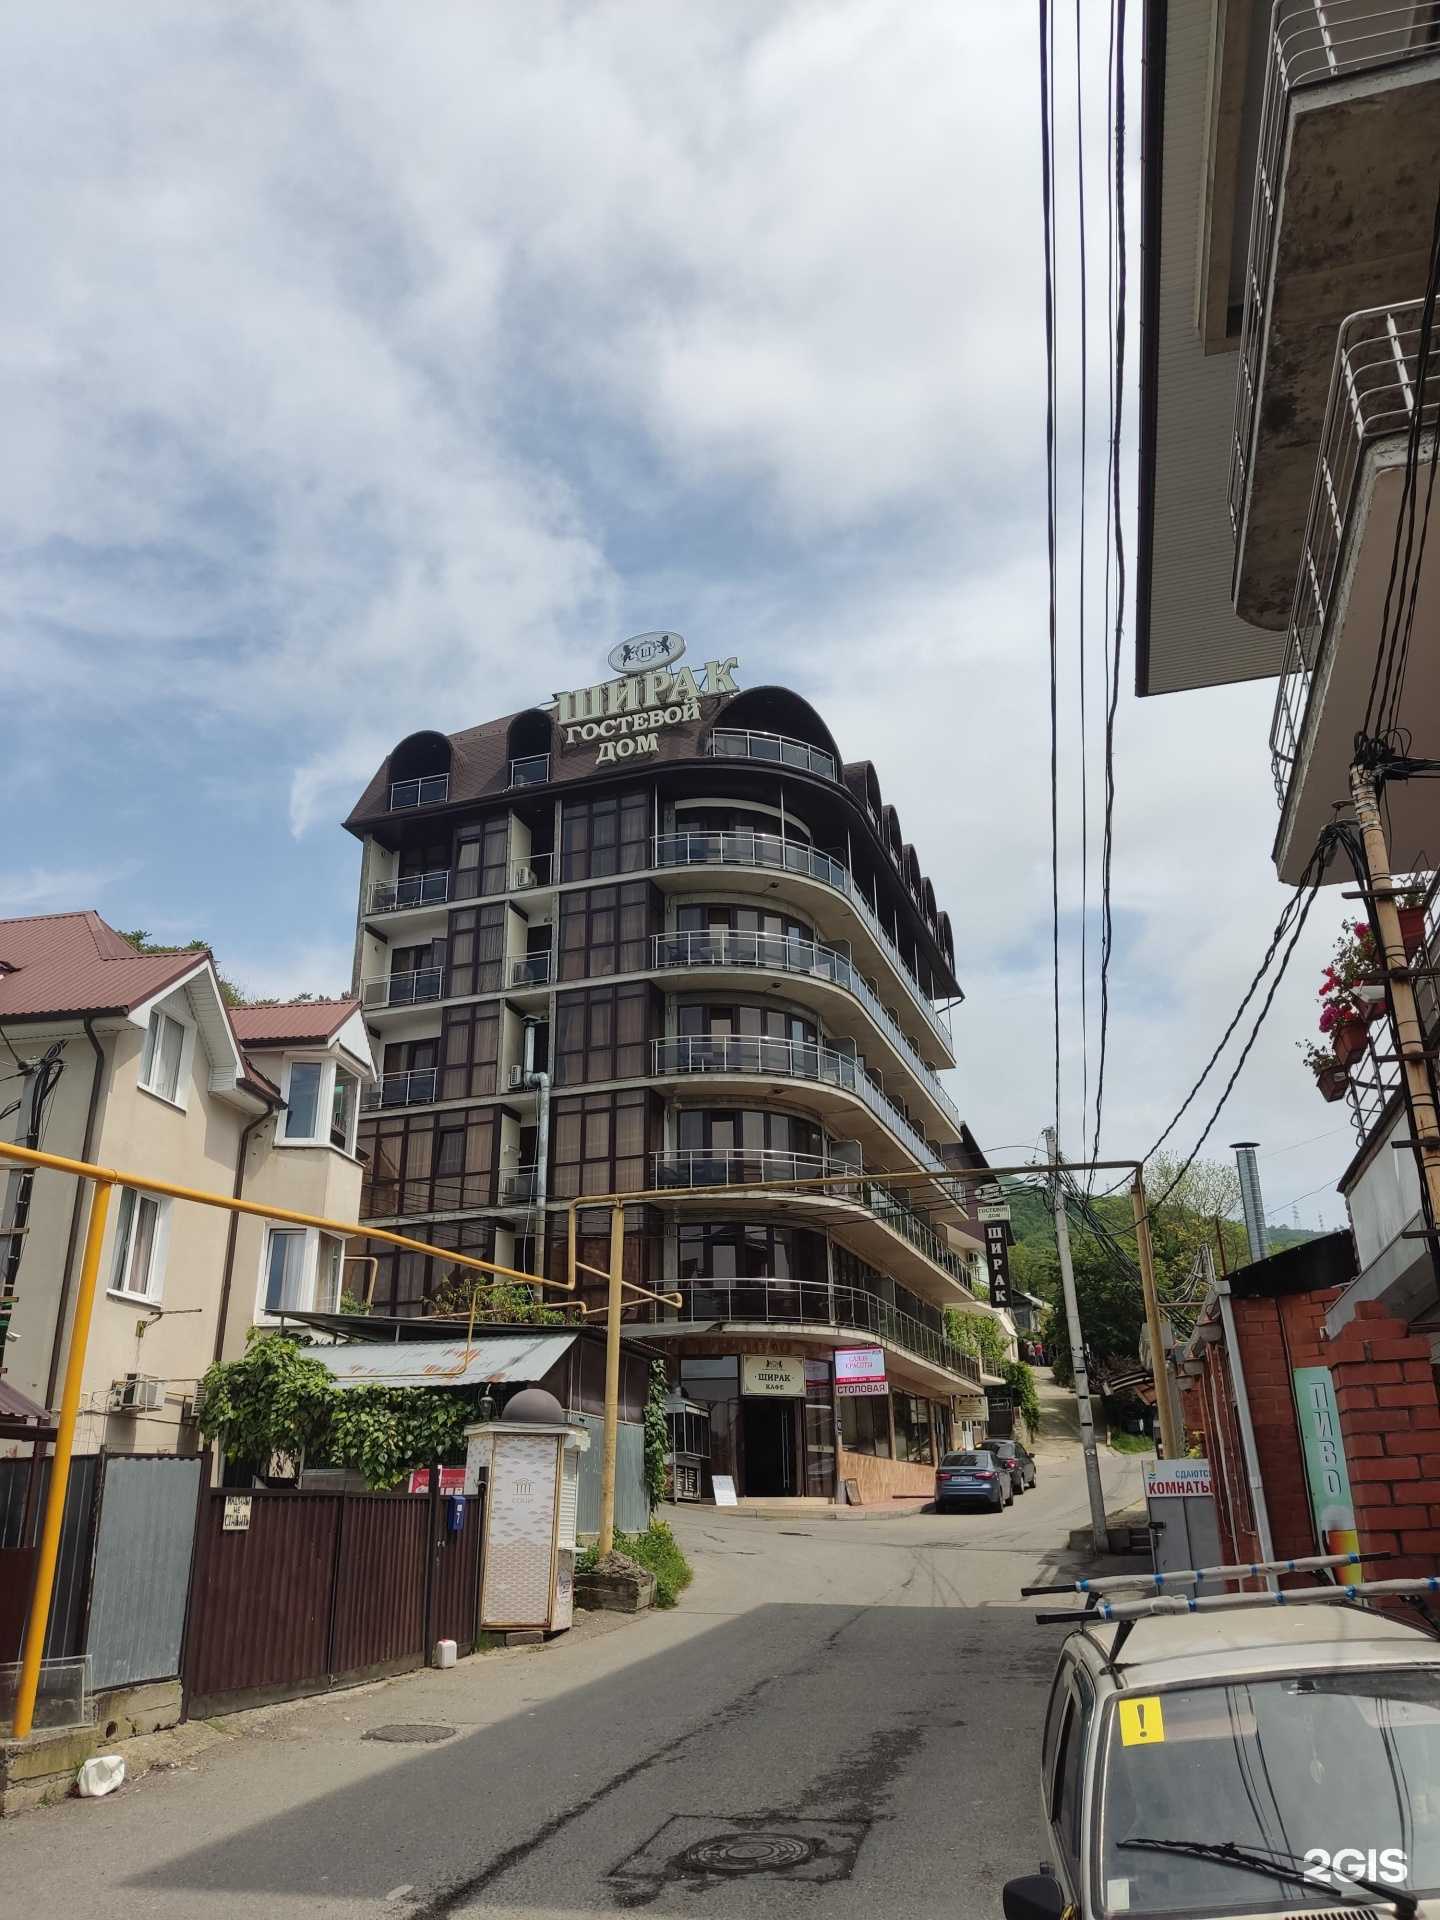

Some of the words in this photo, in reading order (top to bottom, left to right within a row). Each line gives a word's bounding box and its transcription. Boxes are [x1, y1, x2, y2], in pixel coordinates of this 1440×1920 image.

[558, 657, 740, 725] ШИРАК
[566, 696, 702, 744] ГОСТЕВОЙ
[595, 732, 660, 765] ДОМ
[987, 1226, 1007, 1303] ШИРАК
[758, 1373, 791, 1382] ШИРАК
[837, 1384, 885, 1394] СТОЛОВАЯ
[1309, 1382, 1342, 1497] ПИВО
